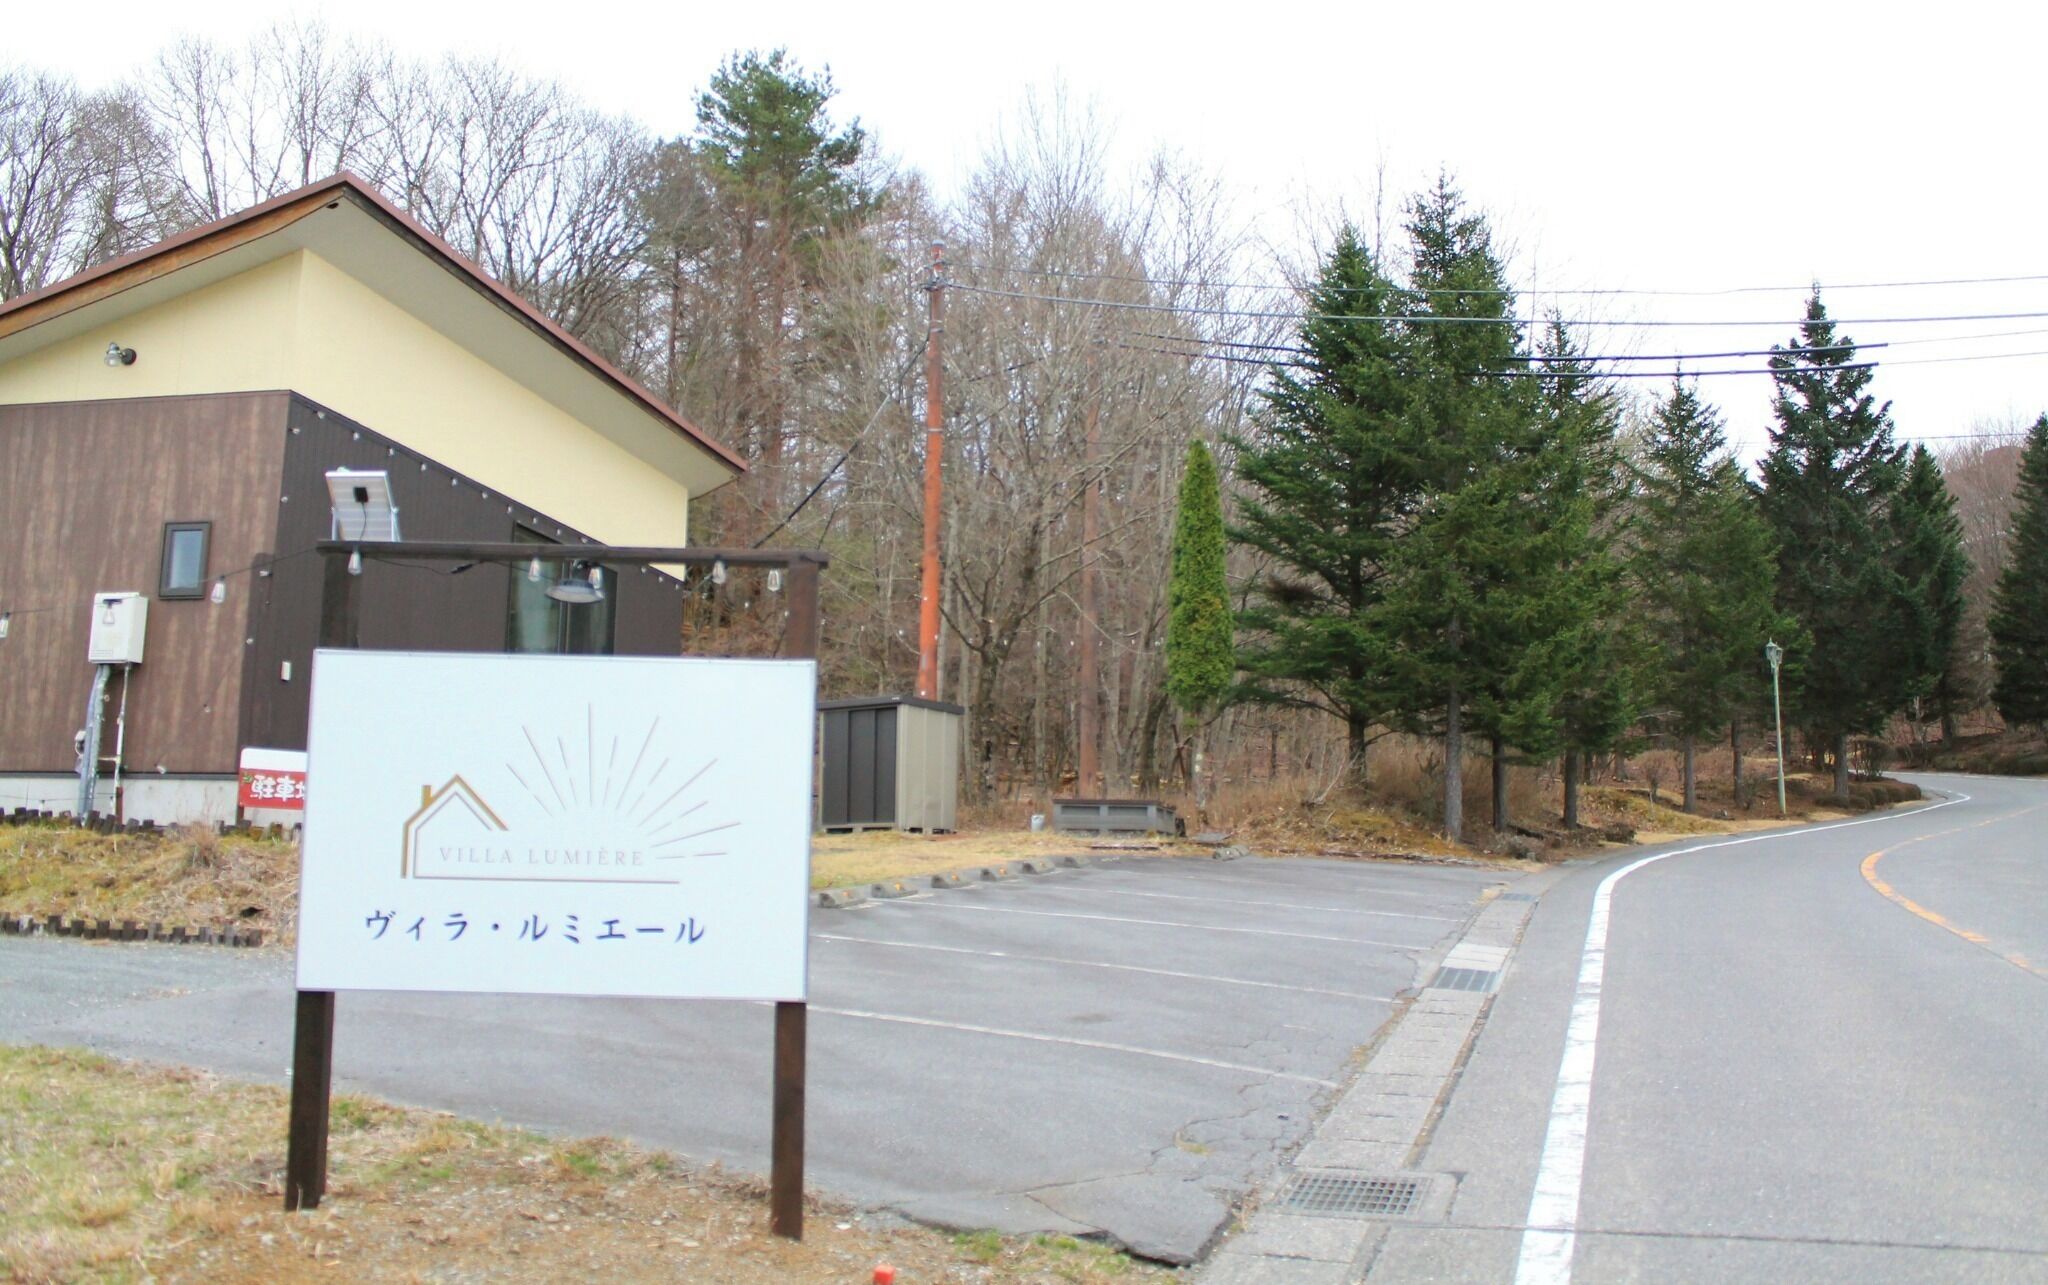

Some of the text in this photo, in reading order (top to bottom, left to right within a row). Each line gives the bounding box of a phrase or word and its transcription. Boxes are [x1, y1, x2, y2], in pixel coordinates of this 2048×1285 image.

[440, 847, 643, 866] VILLA LUMIÈRE
[365, 908, 705, 945] ヴィラ・ルミエール
